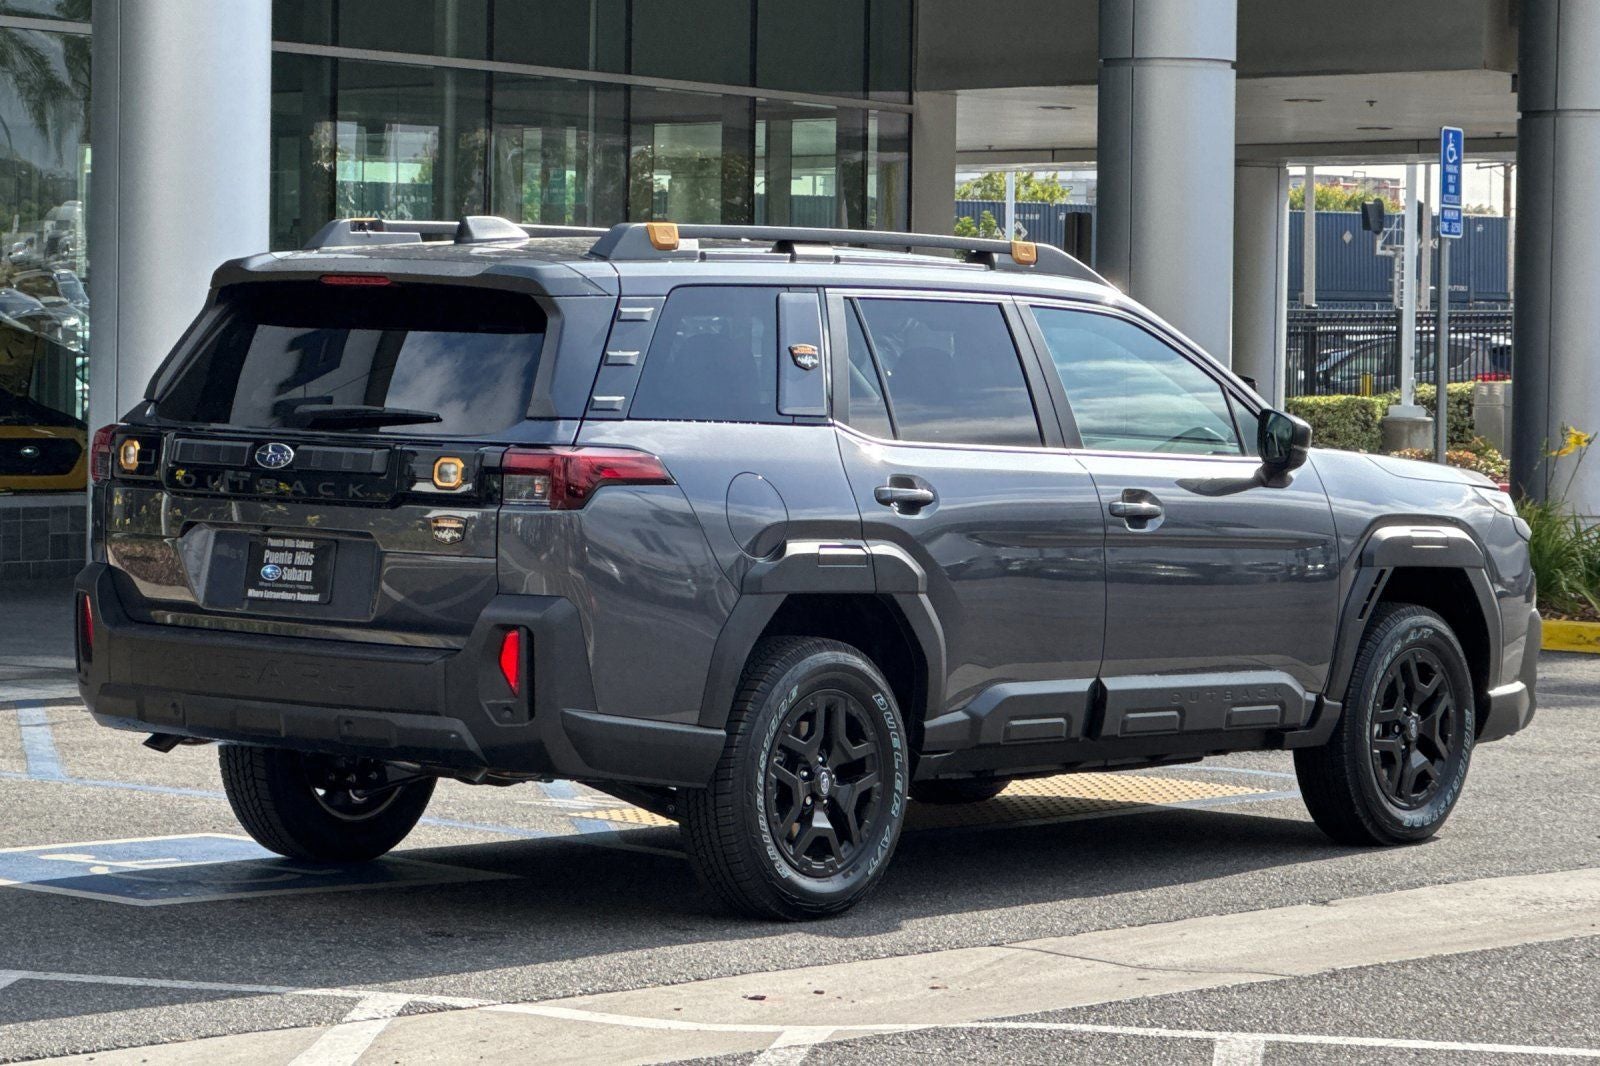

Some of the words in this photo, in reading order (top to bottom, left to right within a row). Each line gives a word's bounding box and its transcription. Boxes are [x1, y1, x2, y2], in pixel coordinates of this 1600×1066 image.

[179, 473, 365, 498] OUTBACK
[263, 549, 293, 565] Puente
[294, 551, 315, 566] Hills
[282, 566, 313, 582] Subaru
[1170, 687, 1283, 705] OUTBACK
[872, 692, 905, 819] DUELER
